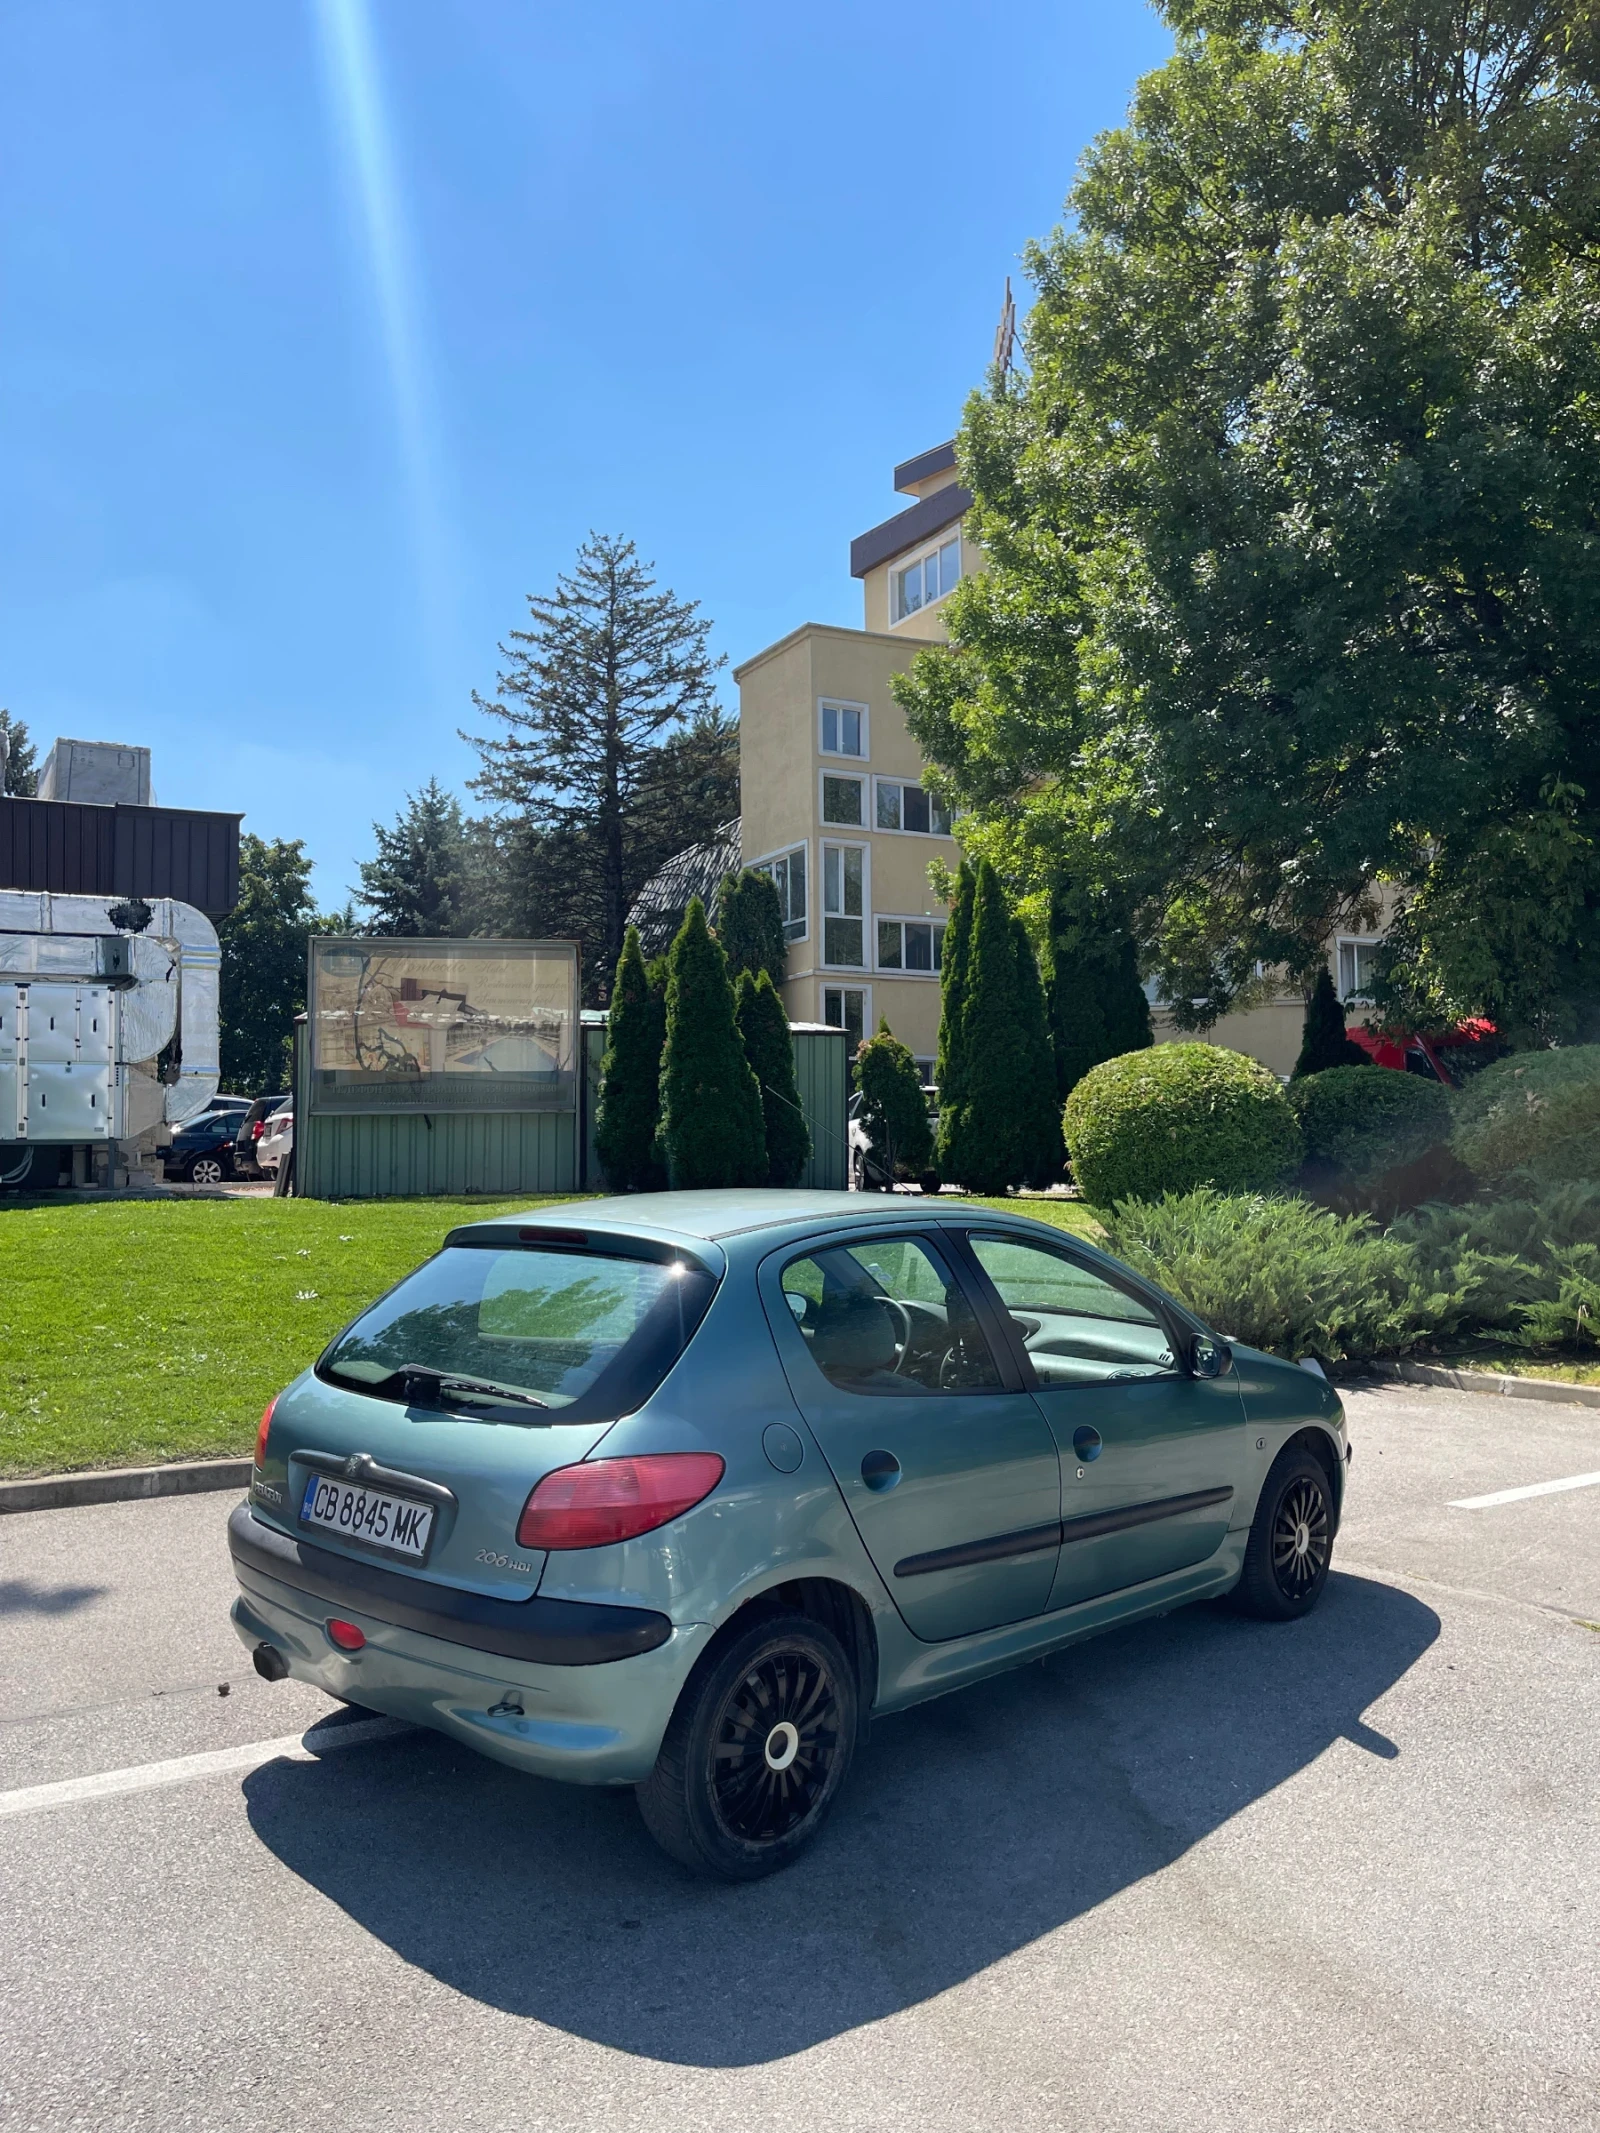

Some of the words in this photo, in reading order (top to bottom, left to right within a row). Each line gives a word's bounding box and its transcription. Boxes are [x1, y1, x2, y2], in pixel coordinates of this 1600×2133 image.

[474, 960, 509, 973] Hotel
[474, 976, 533, 989] Restaurant
[532, 977, 567, 993] garden
[314, 1484, 339, 1521] CB
[340, 1492, 392, 1538] 8845
[390, 1505, 428, 1549] MK
[474, 1549, 509, 1568] 206
